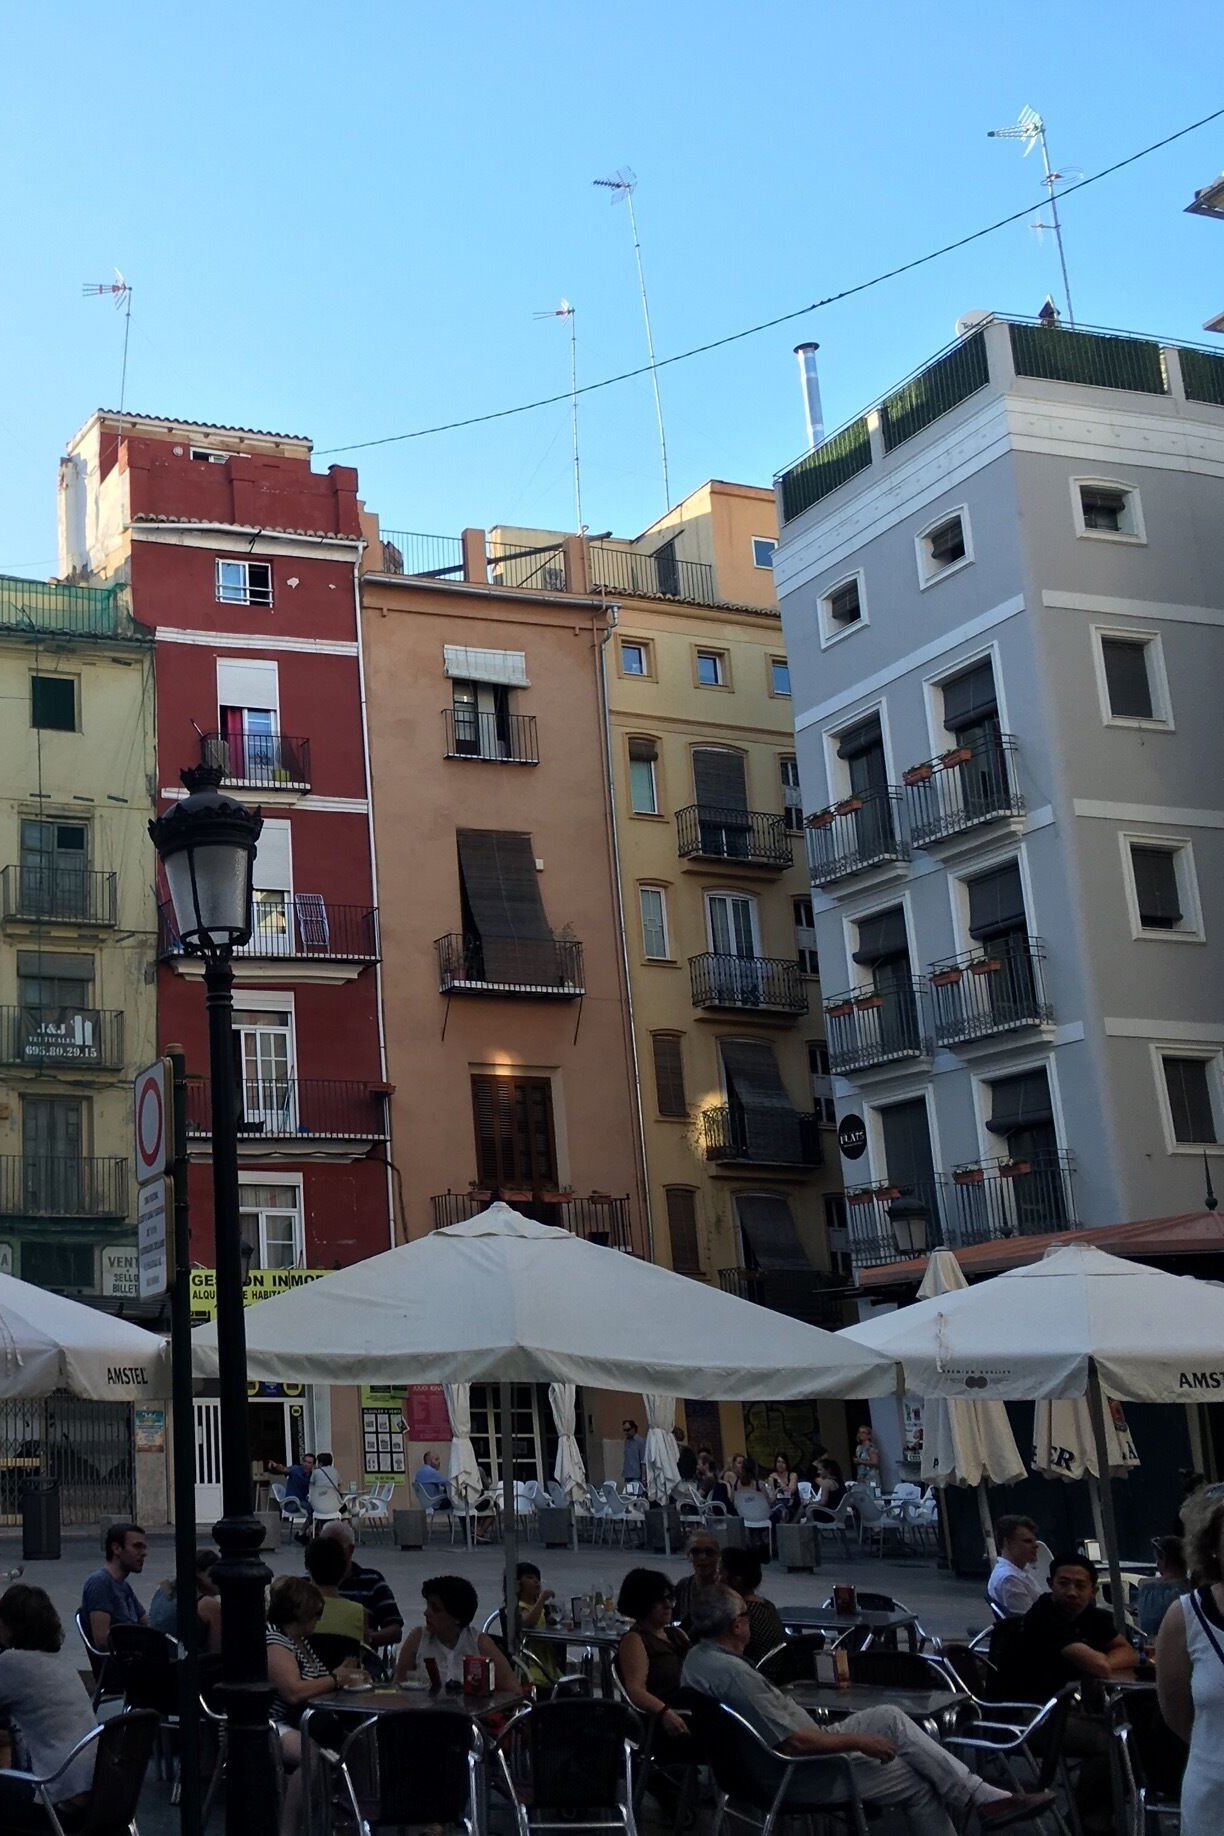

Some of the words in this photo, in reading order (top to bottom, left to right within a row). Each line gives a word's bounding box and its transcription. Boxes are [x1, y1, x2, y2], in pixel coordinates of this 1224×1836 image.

[37, 1023, 66, 1035] J&J
[108, 1256, 138, 1268] VENT
[114, 1273, 139, 1282] SELLO
[113, 1283, 138, 1294] BILLET
[107, 1367, 148, 1385] AMSTEL
